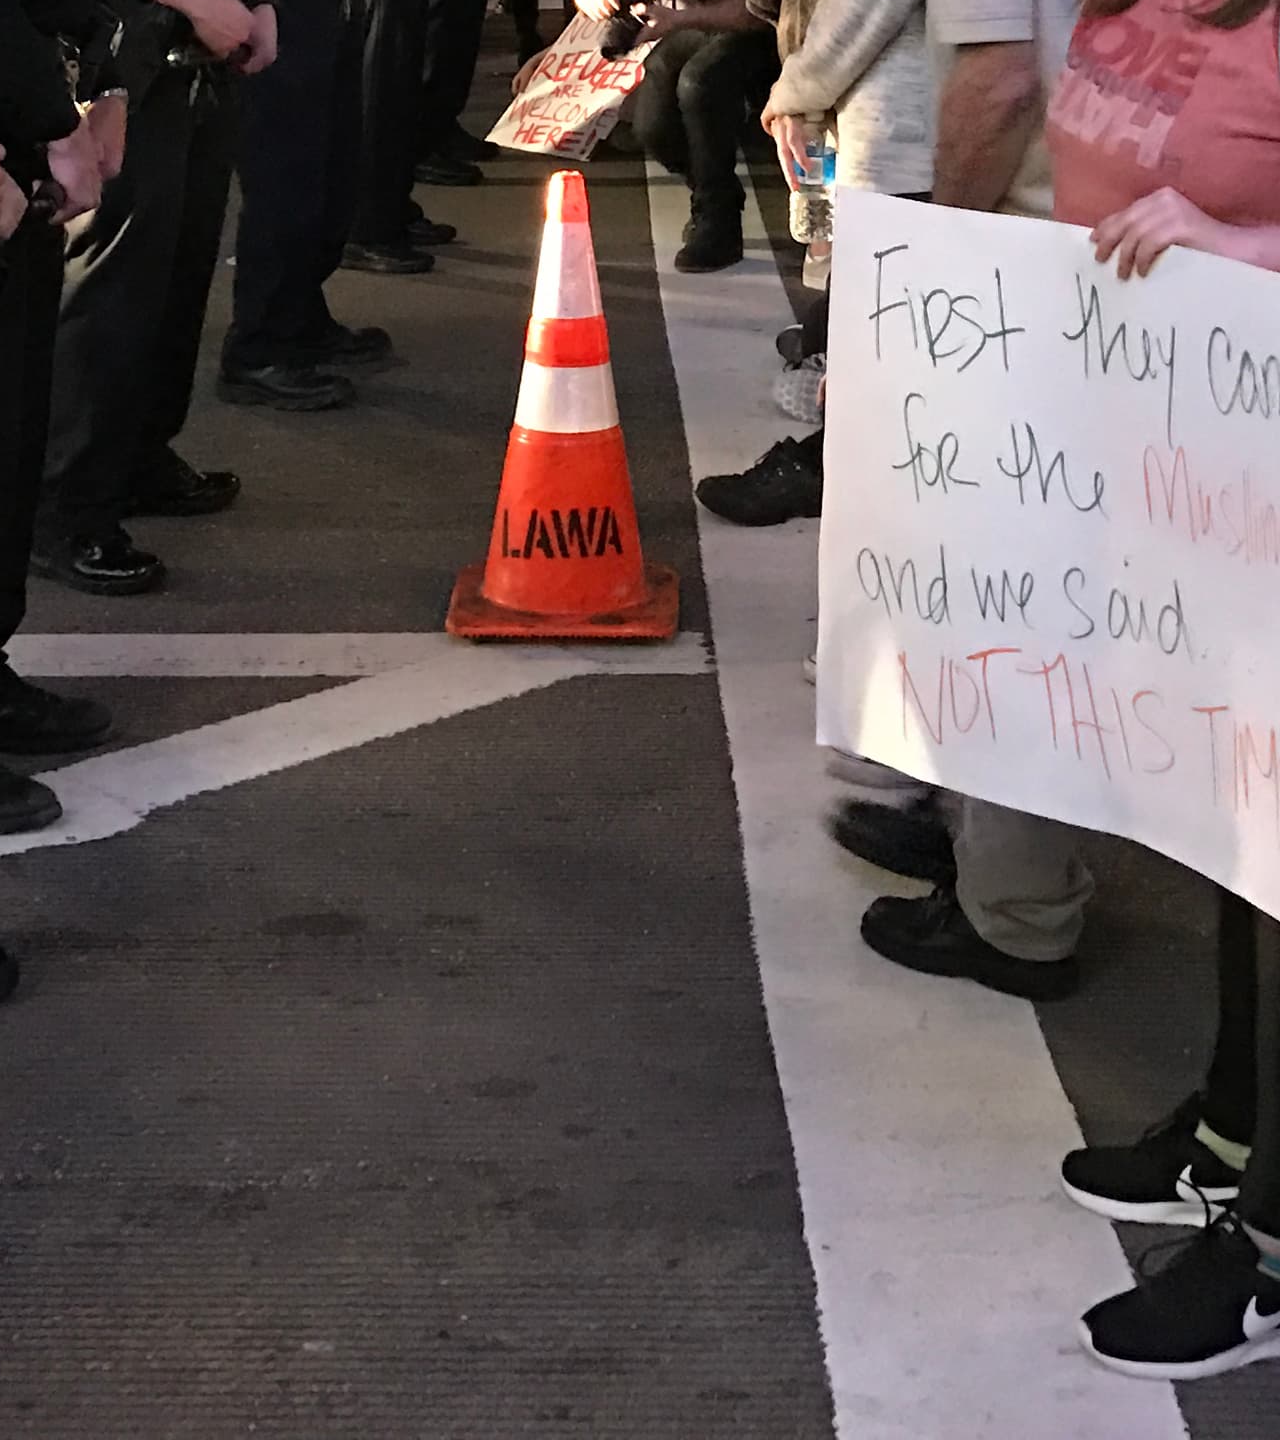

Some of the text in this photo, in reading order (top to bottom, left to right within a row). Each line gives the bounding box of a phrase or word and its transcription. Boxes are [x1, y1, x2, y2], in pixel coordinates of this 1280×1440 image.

[530, 49, 645, 96] REFUGEES
[551, 83, 584, 98] ARE
[507, 95, 617, 127] WELCOME
[512, 122, 597, 153] HERE!
[1062, 273, 1176, 448] they
[997, 423, 1108, 520] the
[502, 506, 623, 559] LAWA
[857, 544, 951, 626] and
[971, 567, 1035, 630] we
[897, 648, 1021, 745] NOT
[1017, 653, 1175, 781] THIS
